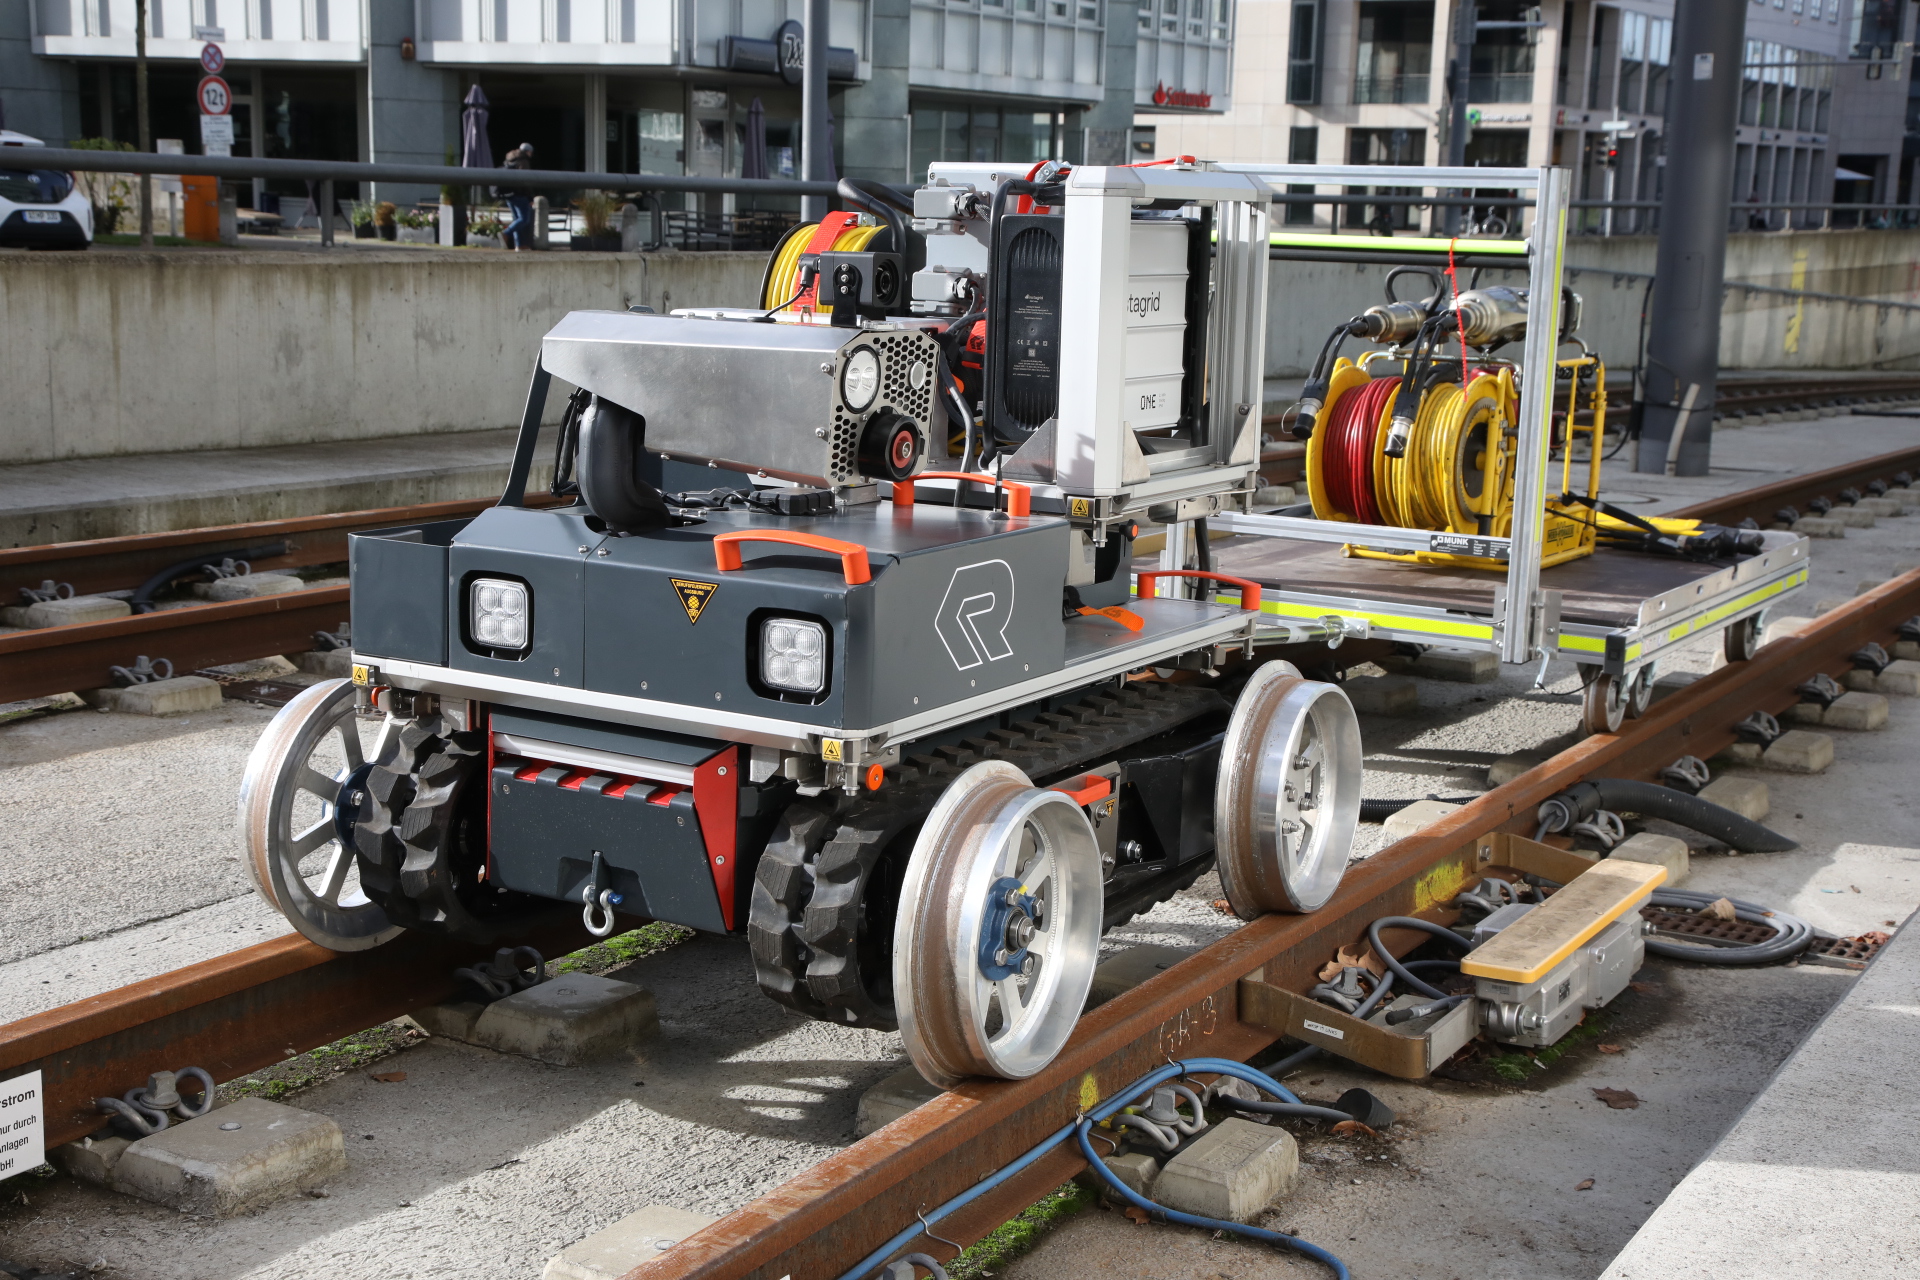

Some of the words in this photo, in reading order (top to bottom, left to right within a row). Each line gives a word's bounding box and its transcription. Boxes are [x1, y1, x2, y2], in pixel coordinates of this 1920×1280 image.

[205, 88, 225, 106] 12t
[1127, 291, 1160, 317] tagrid
[1140, 394, 1156, 410] ONE
[1444, 537, 1469, 546] MUNK
[0, 1089, 35, 1108] strom
[13, 1115, 37, 1131] durch
